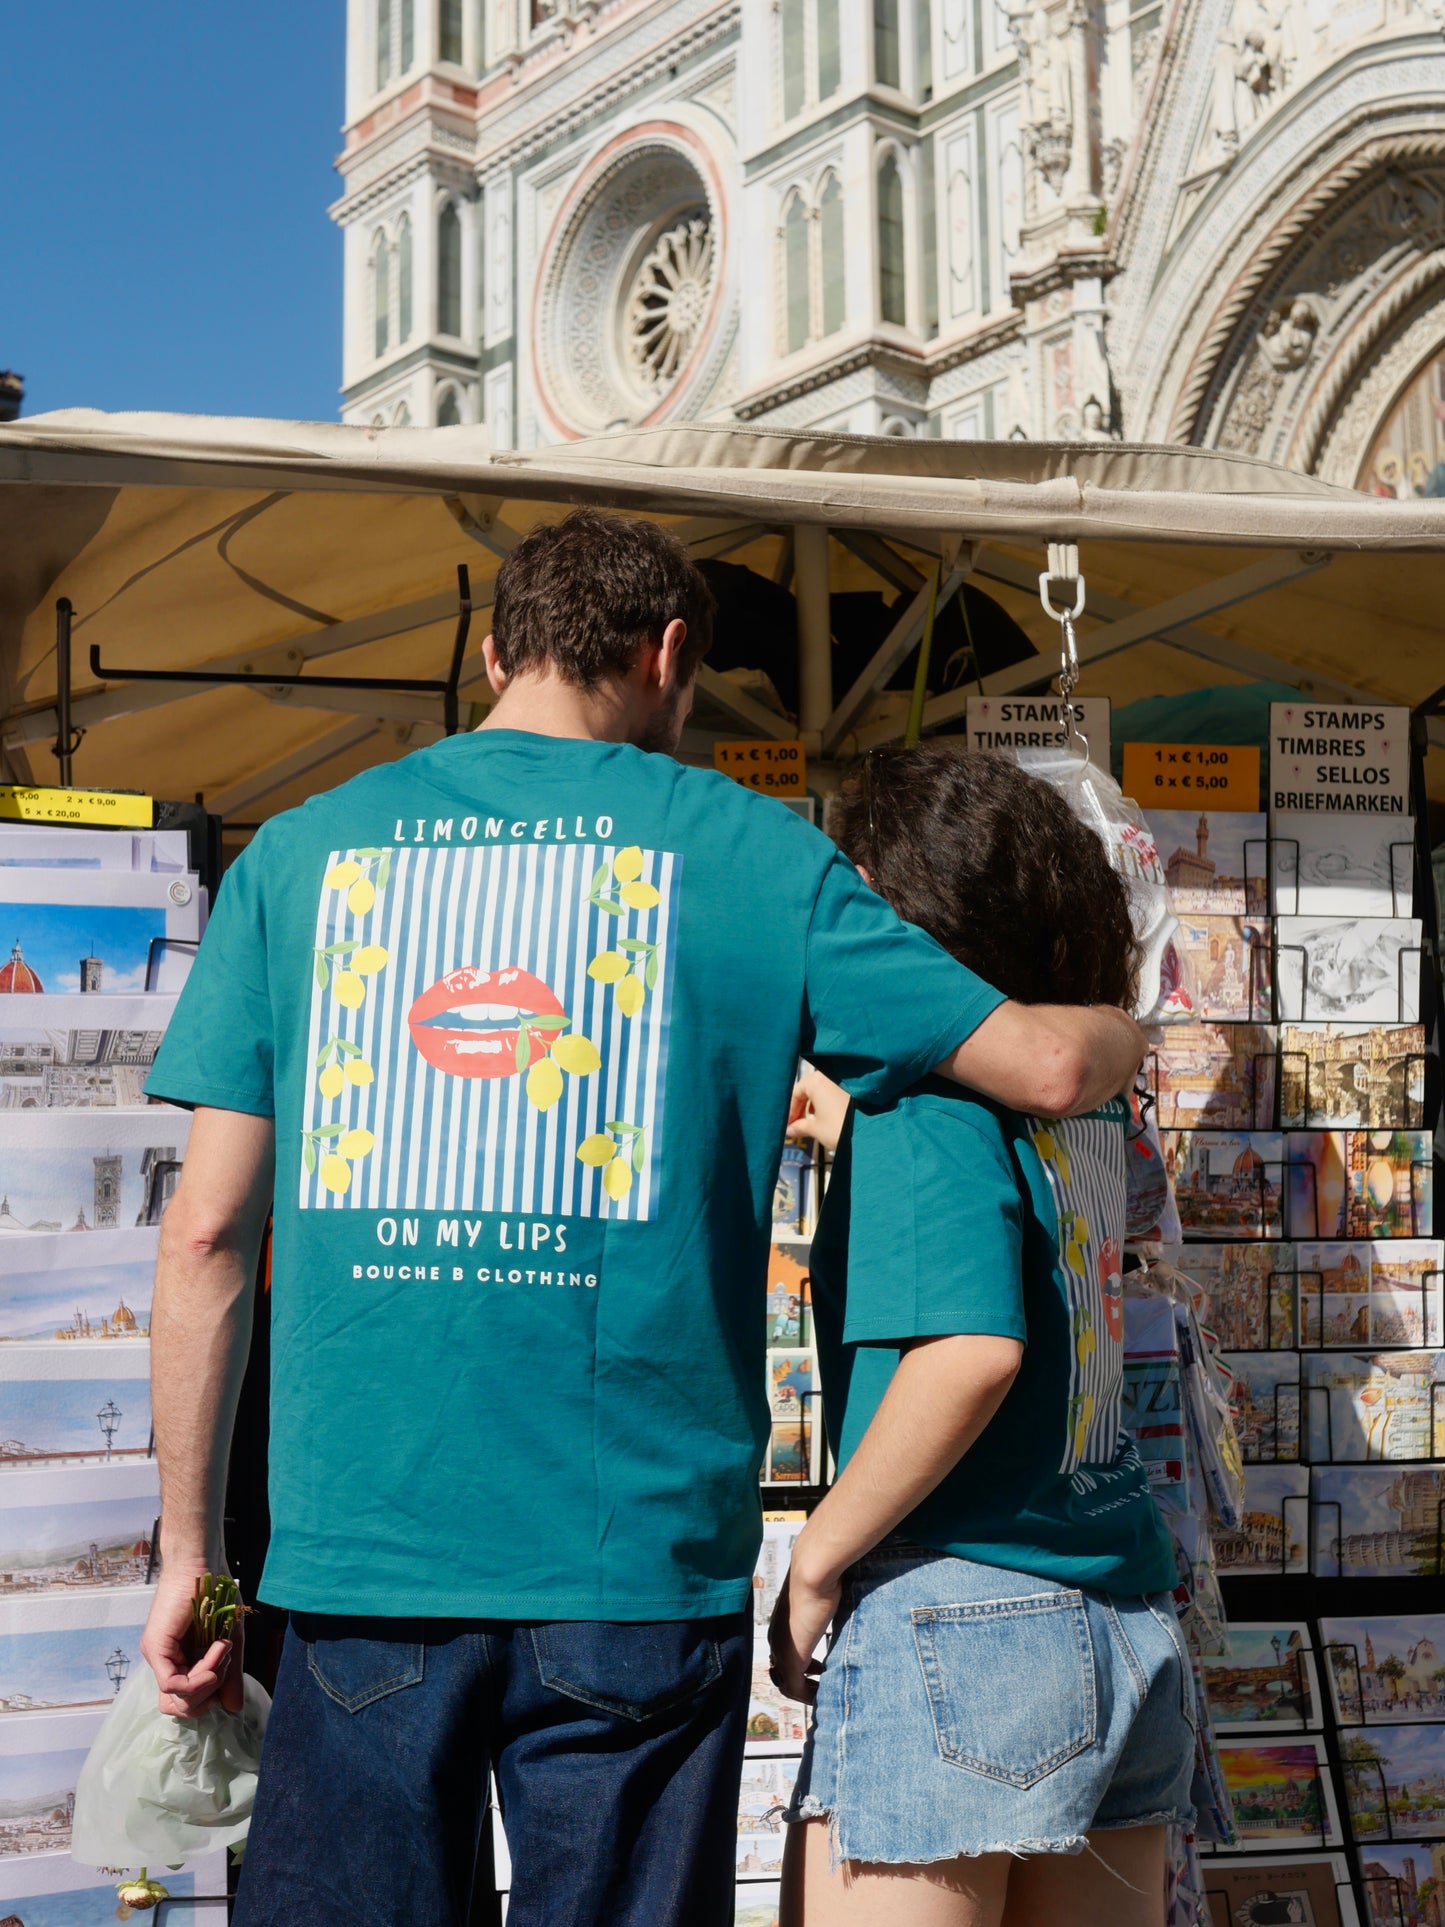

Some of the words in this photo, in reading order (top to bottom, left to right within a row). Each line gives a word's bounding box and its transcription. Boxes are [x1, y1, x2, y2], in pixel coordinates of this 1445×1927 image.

[1001, 704, 1085, 721] STAMPS
[1303, 711, 1385, 730] STAMPS
[720, 749, 728, 761] 1
[735, 751, 744, 761] x
[764, 748, 798, 762] 1,00
[1277, 737, 1366, 757] TIMBRES
[1155, 750, 1162, 763] 1
[1168, 753, 1177, 763] x
[1196, 751, 1229, 766] 1,00
[765, 773, 799, 787] 5,00
[1154, 774, 1164, 787] 6
[1168, 777, 1177, 787] x
[1196, 775, 1229, 791] 5,00
[1316, 766, 1390, 785] SELLOS
[1274, 792, 1403, 813] BRIEFMARKEN
[394, 815, 613, 842] LIMONCELLO
[376, 1217, 419, 1246] ON
[436, 1219, 482, 1248] MY
[500, 1221, 567, 1253] LIPS
[352, 1265, 439, 1281] BOUCHE
[453, 1267, 463, 1281] B
[477, 1267, 597, 1288] CLOTHING
